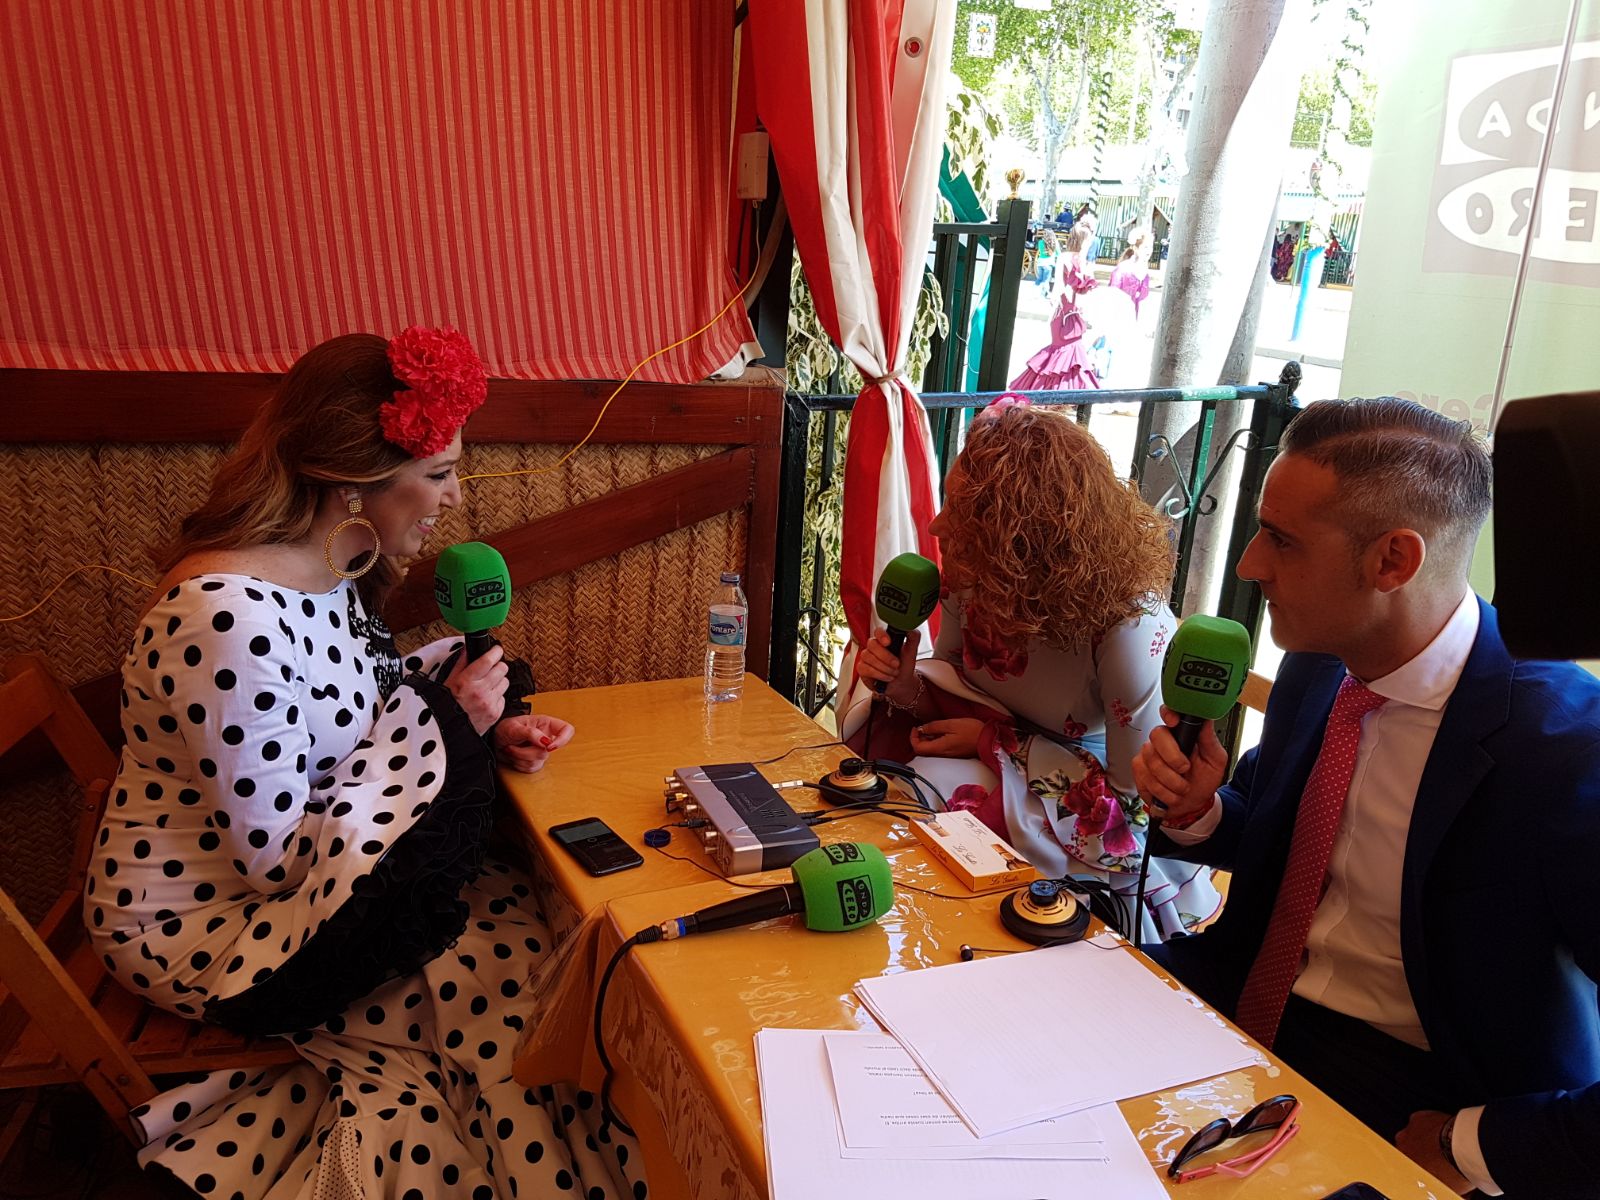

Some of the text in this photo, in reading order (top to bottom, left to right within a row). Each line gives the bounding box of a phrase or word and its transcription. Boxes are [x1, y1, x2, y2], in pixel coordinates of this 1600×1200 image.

[471, 583, 501, 594] ONDA
[475, 593, 502, 604] CERO
[1187, 662, 1223, 676] ONDA
[1184, 676, 1220, 689] CERO
[845, 888, 856, 919] CERO
[858, 883, 868, 915] ONDA
